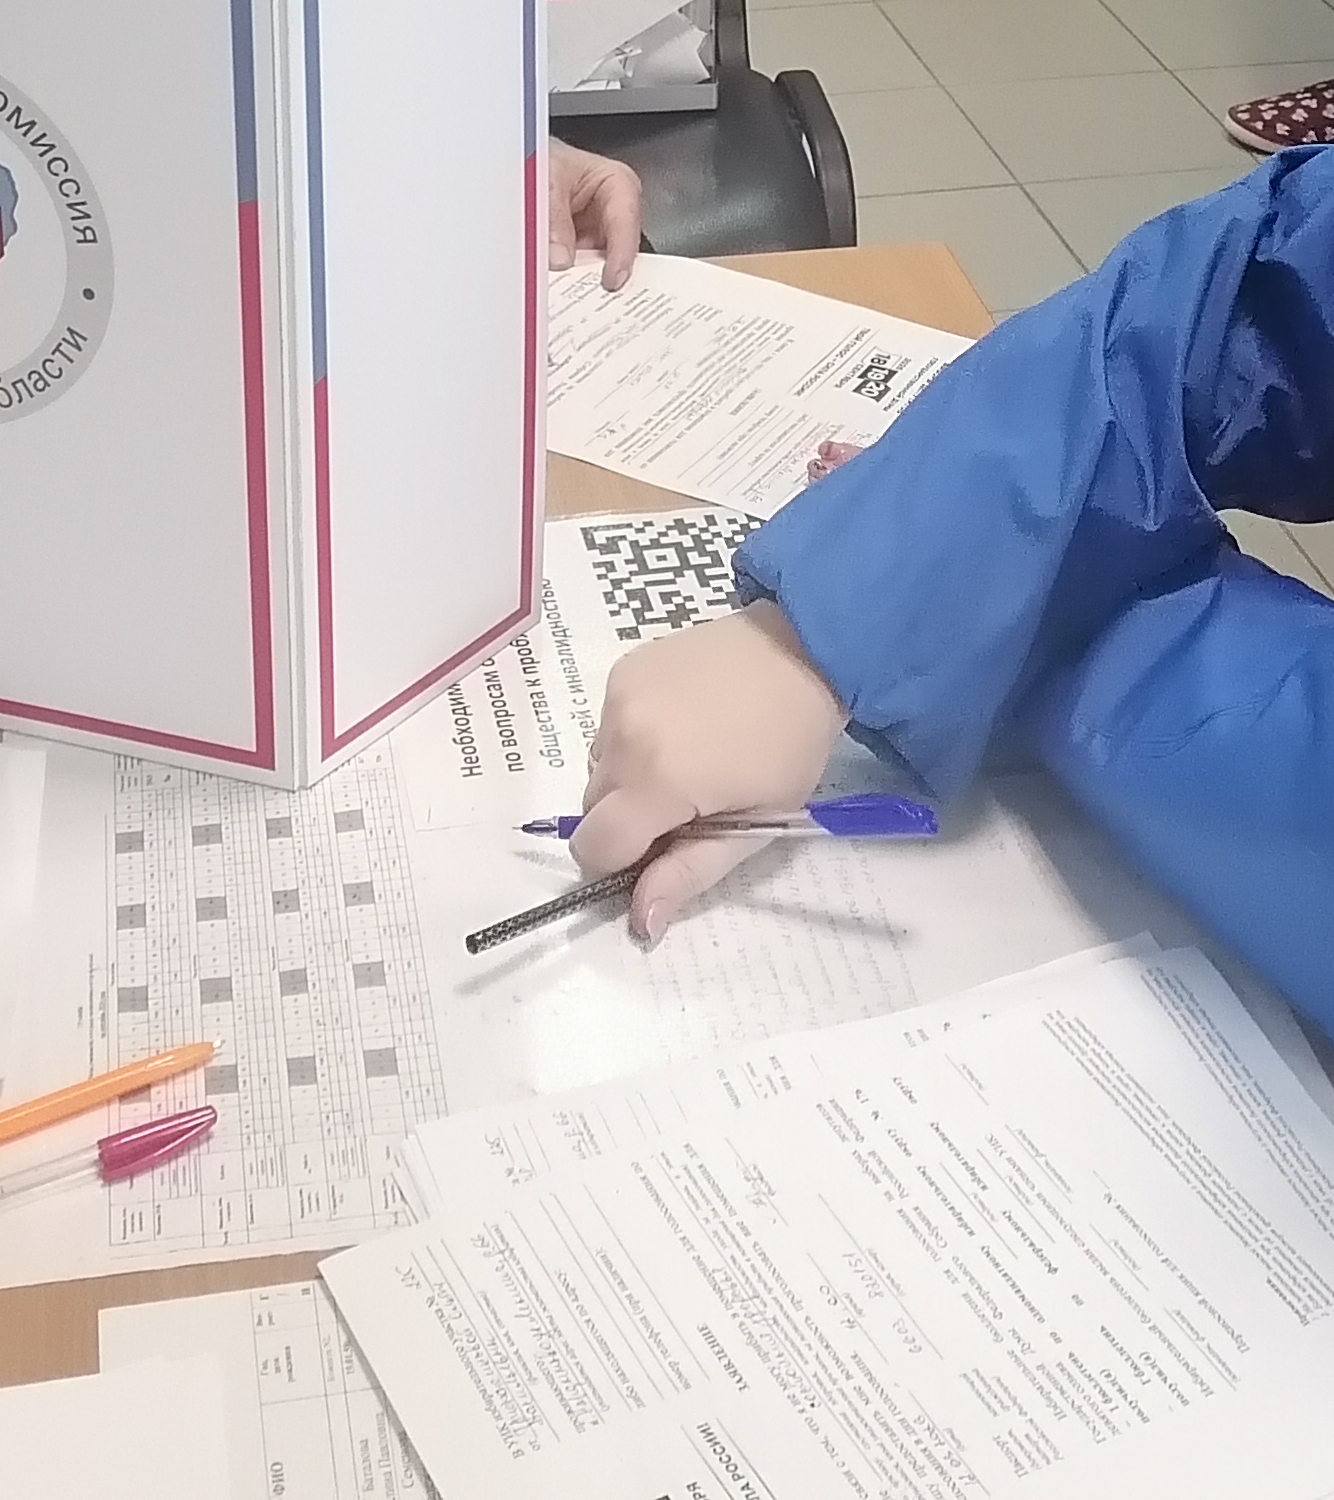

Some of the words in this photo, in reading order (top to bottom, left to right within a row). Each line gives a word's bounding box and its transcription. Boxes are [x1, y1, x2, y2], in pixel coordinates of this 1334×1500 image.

[865, 362, 888, 384] 19
[869, 348, 891, 369] 18
[859, 378, 883, 401] 20
[528, 678, 542, 688] к
[485, 676, 523, 747] вопросам
[530, 688, 565, 768] общества
[505, 750, 525, 773] по
[891, 1075, 920, 1104] округу
[813, 1102, 851, 1143] депутатов
[825, 1097, 868, 1143] Федерации
[884, 1126, 915, 1158] округу
[629, 1160, 643, 1173] по
[680, 1142, 699, 1160] для
[926, 1120, 991, 1192] избирательному
[693, 1162, 739, 1217] помещения
[865, 1149, 910, 1198] Российской
[1003, 1155, 1038, 1192] членами
[636, 1174, 684, 1233] голосования
[912, 1164, 979, 1237] избирательному
[1033, 1190, 1088, 1248] следующими
[678, 1234, 697, 1253] для
[734, 1220, 752, 1237] вне
[908, 1204, 951, 1248] Собрания
[997, 1208, 1061, 1276] федеральному
[1113, 1203, 1164, 1257] голосования
[690, 1253, 737, 1310] помещение
[747, 1240, 807, 1311] проголосовать
[941, 1267, 961, 1285] для
[977, 1243, 1048, 1323] одномандатному
[1081, 1247, 1110, 1276] выдан
[1159, 1256, 1179, 1274] для
[621, 1292, 646, 1315] (при
[947, 1254, 1007, 1320] Федерального
[1069, 1293, 1085, 1306] по
[1106, 1275, 1153, 1324] бюллетень
[1175, 1272, 1202, 1298] ящик
[432, 1307, 463, 1344] участка
[575, 1302, 588, 1316] по
[957, 1290, 1005, 1344] бюллетени
[1196, 1296, 1253, 1353] Переносной
[582, 1316, 633, 1384] находящегося
[636, 1314, 675, 1360] телефона
[694, 1321, 751, 1393] ЗАЯВЛЕНИЕ
[730, 1315, 772, 1365] прибыть
[800, 1314, 854, 1381] возможность
[1004, 1326, 1035, 1356] Думы
[1048, 1330, 1064, 1344] по
[1095, 1324, 1145, 1378] бюллетень
[666, 1358, 695, 1390] номер
[767, 1364, 792, 1391] могу
[1063, 1349, 1114, 1405] бюллетень
[1137, 1349, 1191, 1407] получил(а)
[1146, 1322, 1216, 1397] Избирательный
[451, 1346, 507, 1422] избирательного
[623, 1385, 646, 1409] либо
[786, 1392, 801, 1406] не
[846, 1349, 902, 1417] голосования.
[851, 1384, 872, 1406] мне
[1004, 1347, 1069, 1421] Избирательные
[1034, 1361, 1108, 1445] Государственной
[1097, 1366, 1152, 1425] получил(а)
[495, 1421, 519, 1448] УИК
[803, 1415, 823, 1435] что
[897, 1417, 918, 1438] дни
[1080, 1392, 1122, 1437] девятого
[511, 1449, 524, 1458] В
[528, 1437, 542, 1450] от
[697, 1422, 745, 1482] РОССИИ!
[817, 1434, 840, 1458] тем,
[869, 1408, 928, 1479] предоставить
[988, 1433, 1030, 1478] Паспорт
[268, 1460, 288, 1496] ФИО
